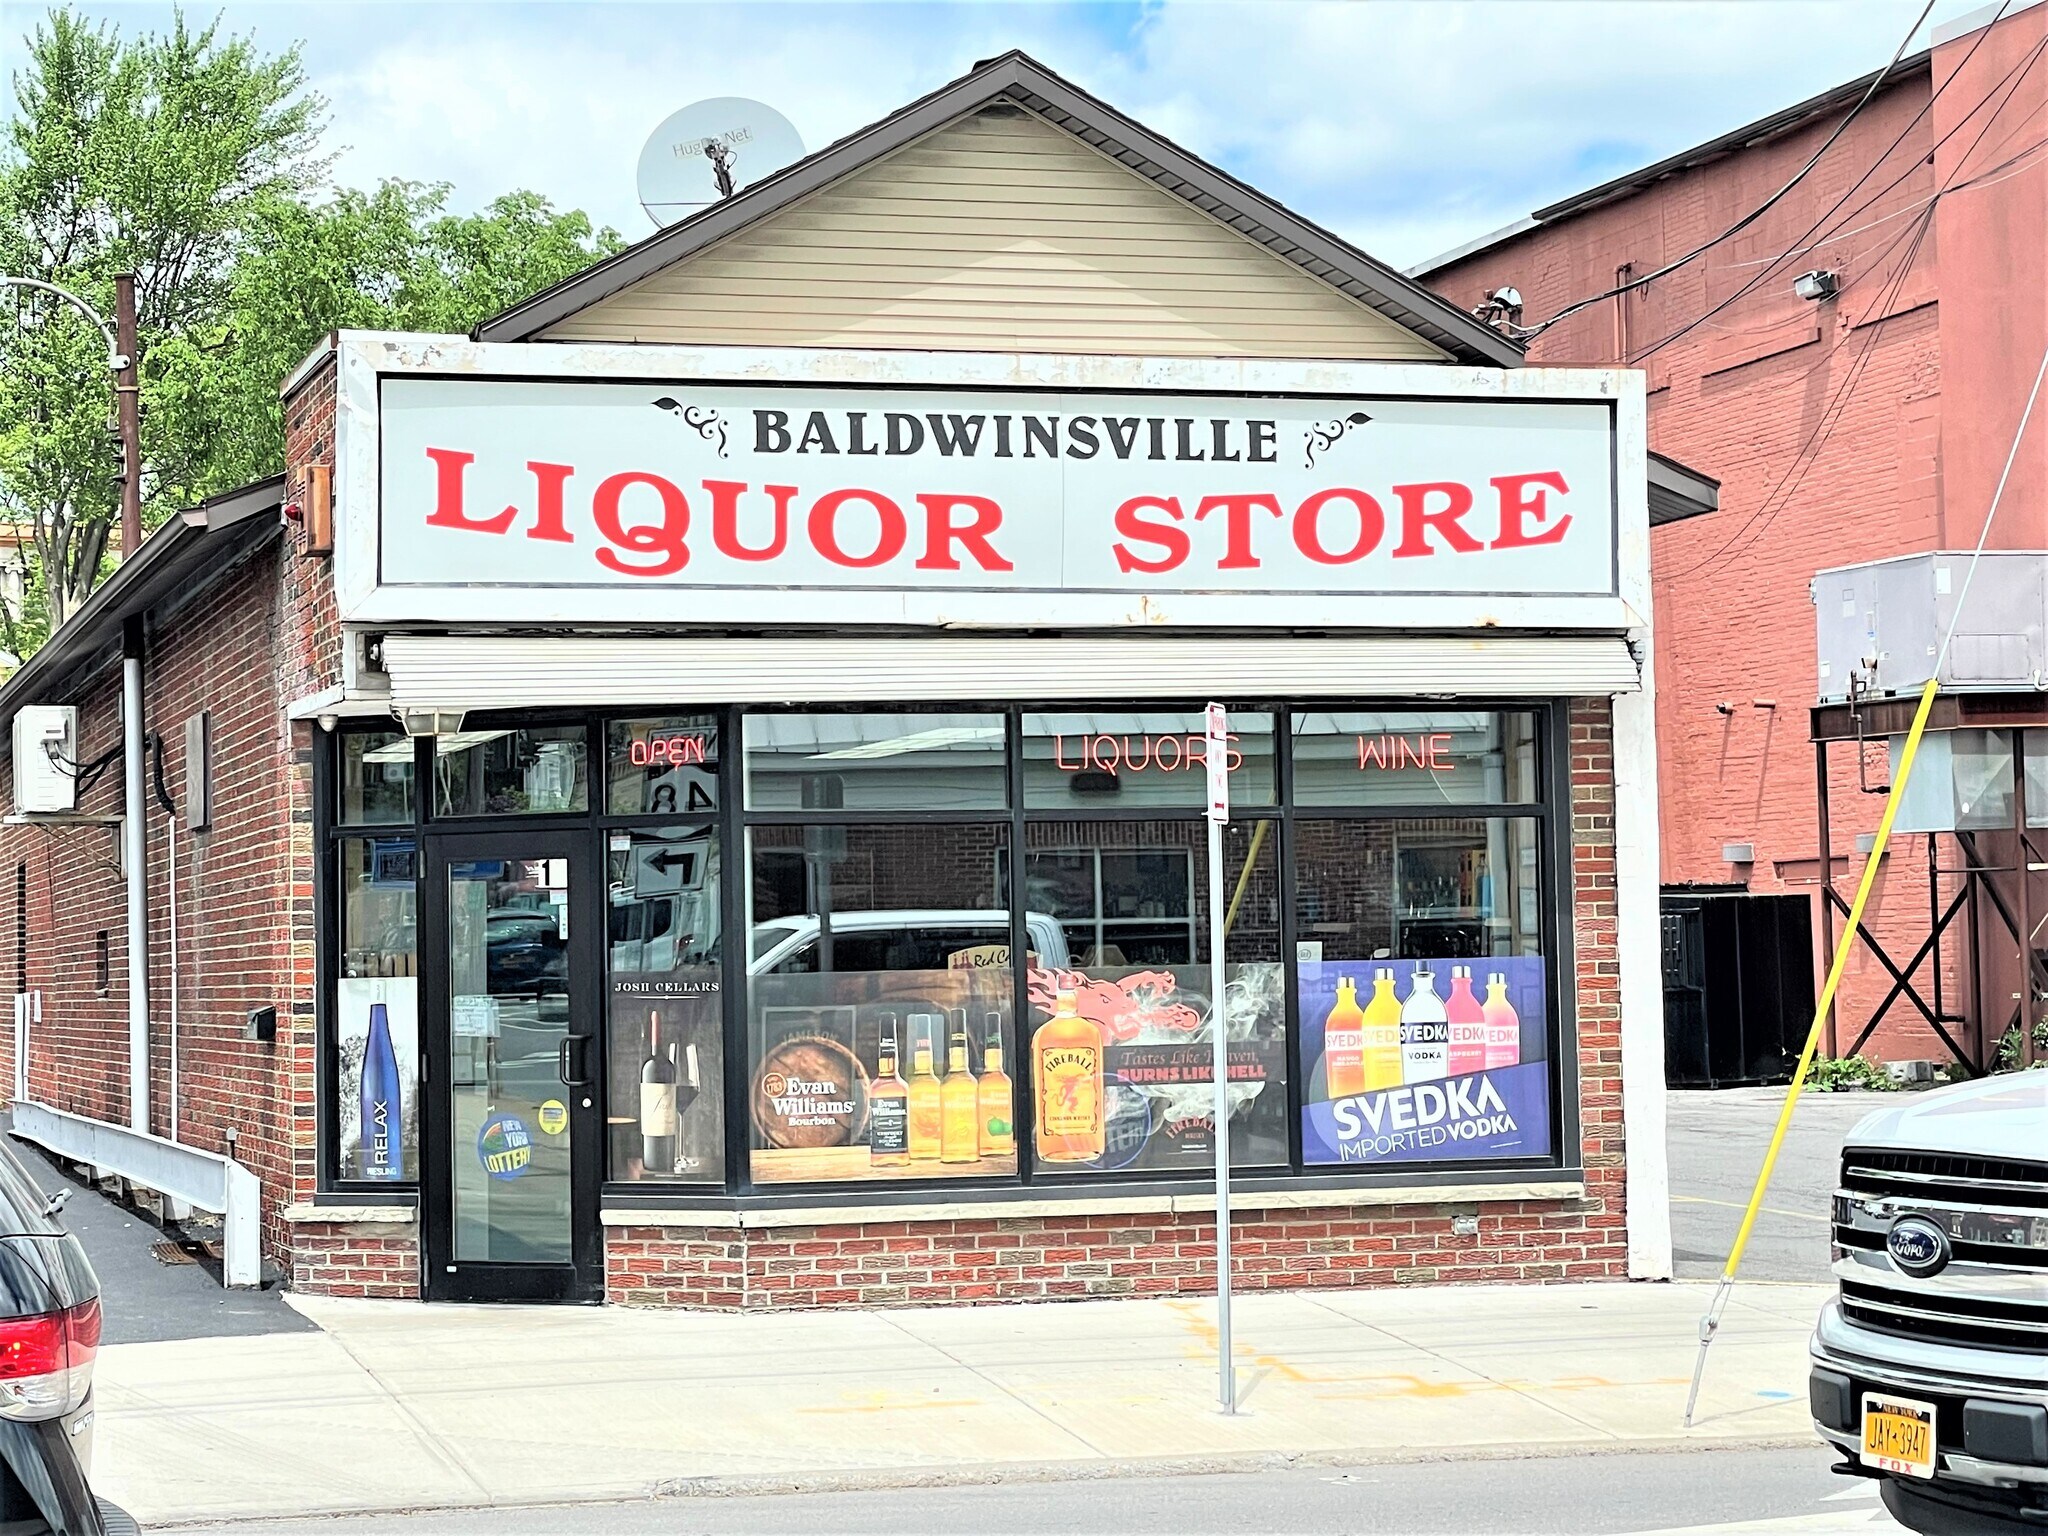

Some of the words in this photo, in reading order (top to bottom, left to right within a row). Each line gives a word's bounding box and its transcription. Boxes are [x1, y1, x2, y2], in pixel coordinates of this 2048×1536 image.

[673, 128, 749, 157] HugNet
[753, 410, 1277, 463] BALDWINSVILLE
[426, 447, 1013, 576] LIQUOR
[1112, 470, 1573, 574] STORE
[630, 737, 704, 766] OPEN
[1055, 734, 1242, 775] LIQUORS
[1358, 734, 1455, 770] WINE
[974, 951, 995, 967] Red
[614, 982, 650, 993] JOSH
[655, 982, 720, 993] CELLARS
[1326, 1034, 1363, 1047] SVEDK
[1400, 1024, 1448, 1042] SVEDKA
[1045, 1053, 1092, 1072] FIREBALL
[1121, 1050, 1165, 1066] Tastes
[1170, 1047, 1198, 1064] Like
[1408, 1051, 1442, 1060] VODKA
[1117, 1067, 1179, 1082] BURNS
[1182, 1066, 1215, 1080] LIK
[1227, 1065, 1267, 1079] HELL
[786, 1077, 837, 1096] Evan
[771, 1097, 854, 1116] Williams
[1332, 1074, 1507, 1140] SVEDKA
[502, 1120, 522, 1131] NEW
[788, 1116, 836, 1126] Bourbon
[1165, 1116, 1216, 1139] FIREBAL
[374, 1098, 389, 1165] RELAX
[505, 1131, 529, 1147] YORK
[1339, 1126, 1448, 1162] IMPORTED
[1446, 1114, 1518, 1142] VODKA
[484, 1145, 532, 1173] LOTTERY
[367, 1167, 397, 1176] RIESLING
[1896, 1231, 1926, 1258] Ford
[1869, 1417, 1892, 1451] JAY
[1899, 1422, 1926, 1459] 3947
[1879, 1457, 1913, 1474] FOX
